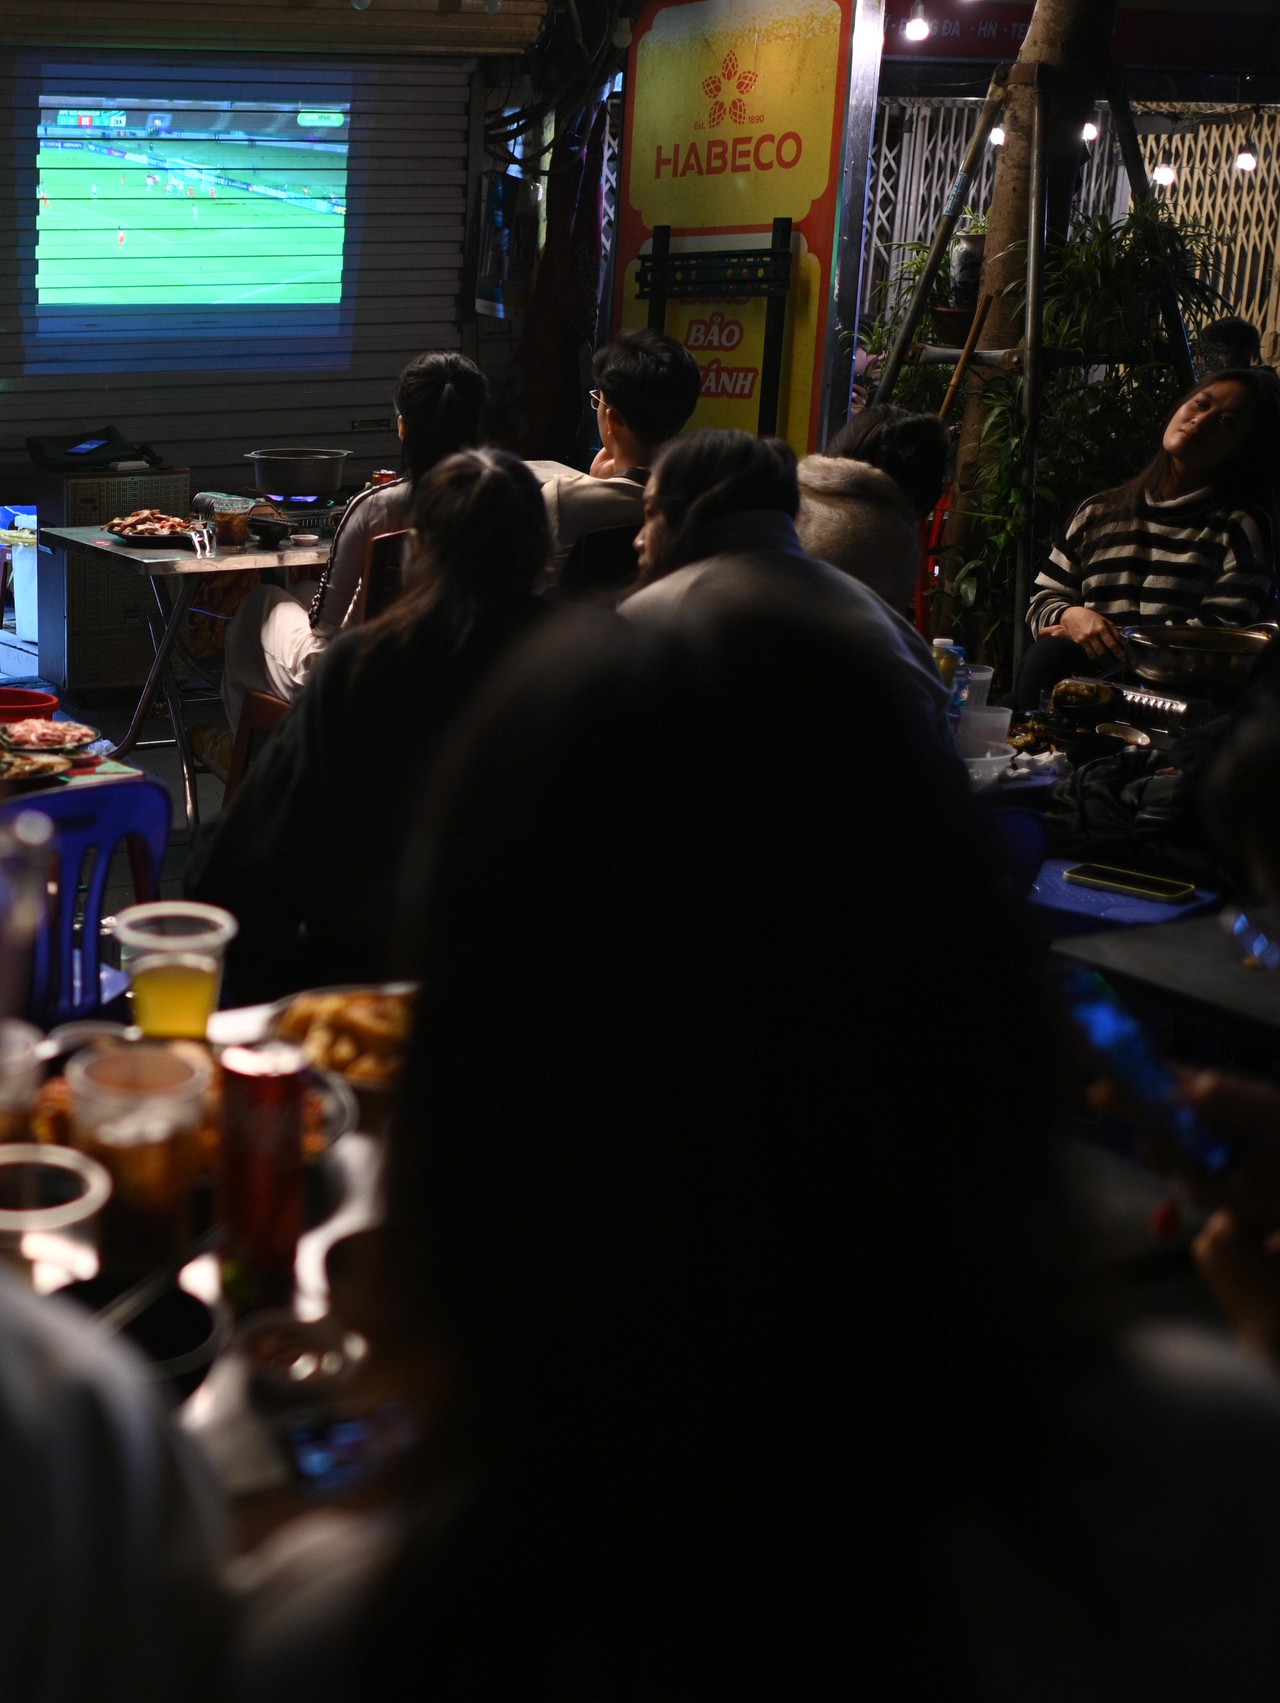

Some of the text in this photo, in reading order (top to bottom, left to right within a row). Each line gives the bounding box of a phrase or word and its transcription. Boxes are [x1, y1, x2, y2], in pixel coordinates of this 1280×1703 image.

[941, 20, 961, 37] ĐA
[976, 21, 999, 39] HN
[694, 122, 706, 130] Est.
[748, 114, 765, 124] 1890
[655, 131, 803, 179] HABECO
[687, 315, 741, 348] BẢO
[699, 363, 755, 395] ÁNH
